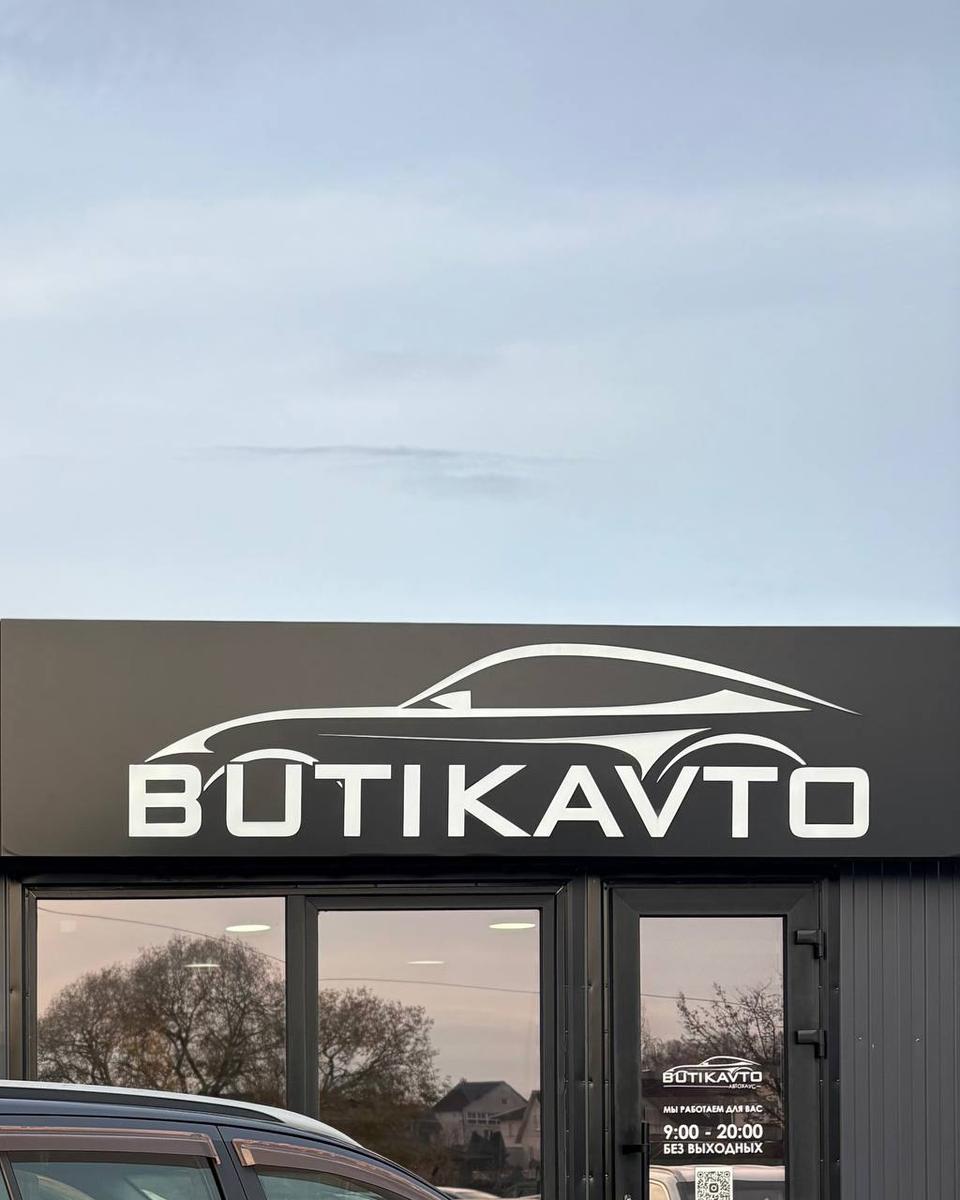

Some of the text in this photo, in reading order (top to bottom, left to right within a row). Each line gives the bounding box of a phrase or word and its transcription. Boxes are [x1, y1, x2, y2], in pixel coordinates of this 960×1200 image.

[128, 762, 870, 839] BUTIKAVTO
[662, 1071, 763, 1084] BUTIKAVTO
[663, 1105, 763, 1114] МЫ РАБОТАЕМ ДЛЯ ВАС
[663, 1124, 700, 1140] 9:00
[716, 1123, 764, 1139] 20:00
[663, 1142, 763, 1155] БЕЗ ВЫХОДНЫХ
